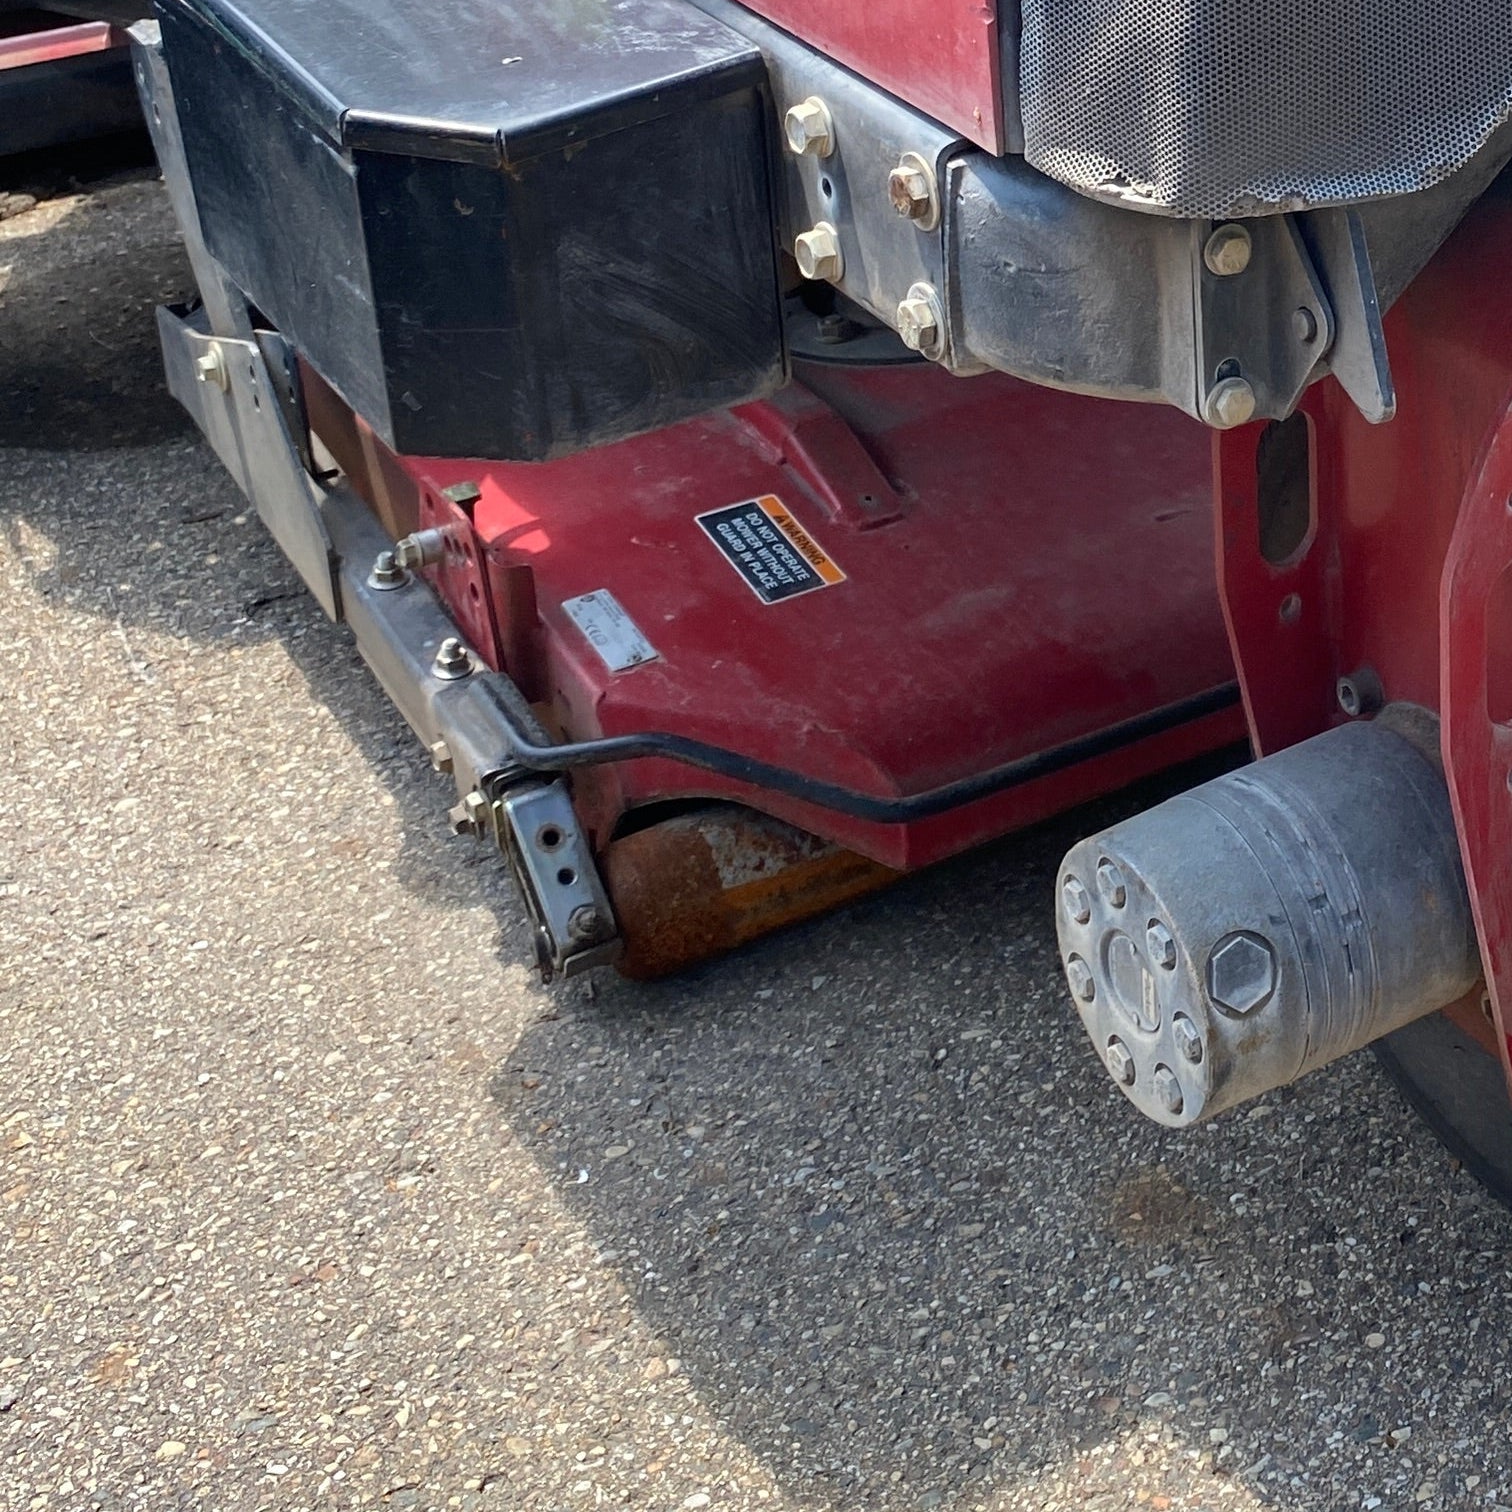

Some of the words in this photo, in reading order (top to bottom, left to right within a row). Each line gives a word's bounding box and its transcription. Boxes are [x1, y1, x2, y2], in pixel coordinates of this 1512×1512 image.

[716, 523, 746, 552] GUARD
[740, 551, 755, 562] IN
[748, 561, 778, 589] PLACE
[731, 517, 763, 549] MOWER
[757, 547, 795, 584] WITHOUT
[745, 512, 763, 526] DO
[757, 525, 778, 543] NOT
[772, 543, 811, 581] OPERATE
[781, 519, 826, 565] WARNING
